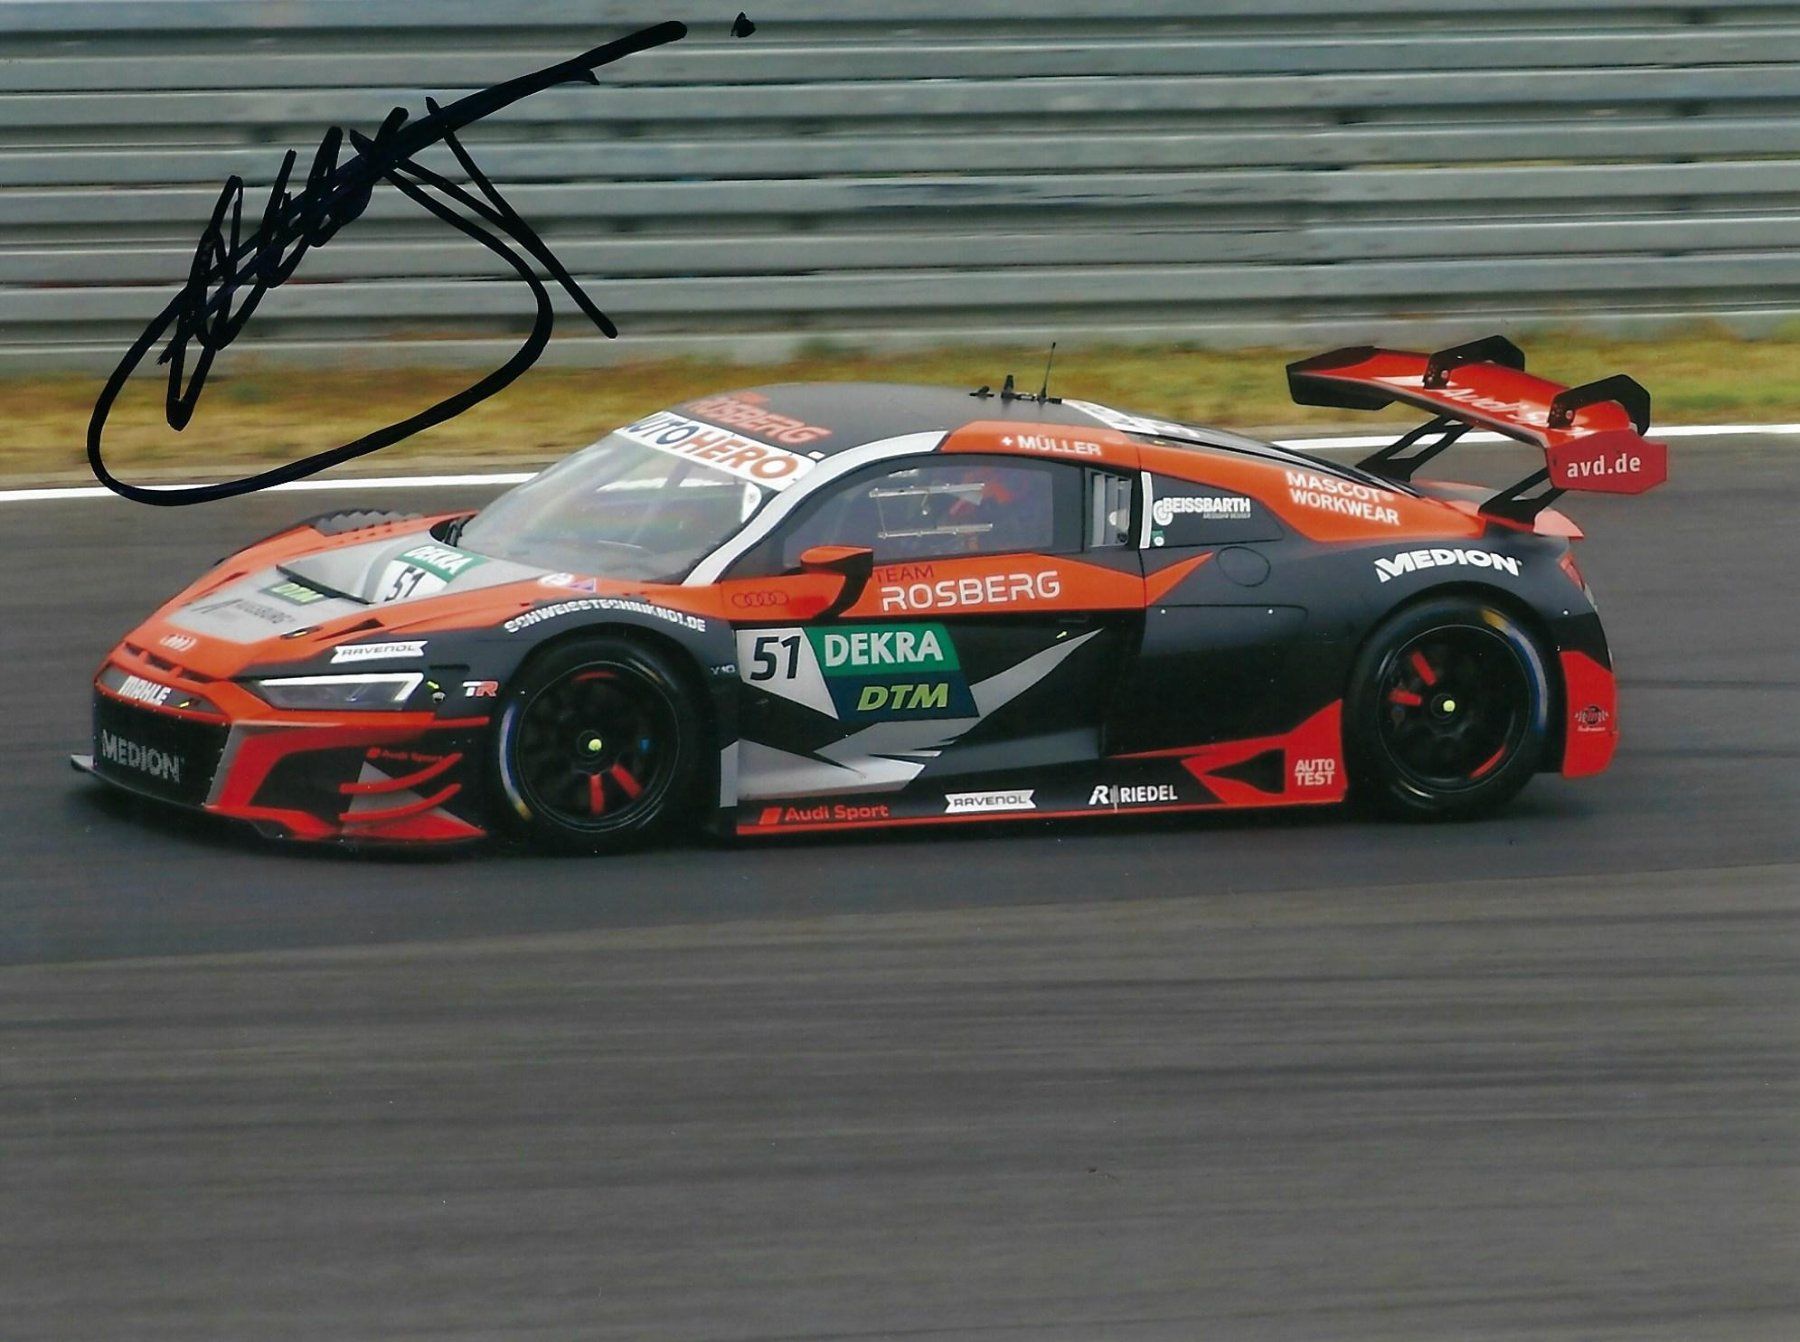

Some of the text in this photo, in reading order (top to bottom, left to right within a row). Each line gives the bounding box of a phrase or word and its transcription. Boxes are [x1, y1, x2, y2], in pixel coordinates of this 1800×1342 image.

[626, 413, 799, 479] UTOHERO
[1017, 435, 1102, 456] MÜLLER
[1566, 453, 1642, 479] avd.de
[1163, 497, 1251, 513] BEISSBARTH
[1290, 488, 1399, 525] WORKWEAR
[876, 565, 935, 583] TEAM
[1374, 549, 1518, 583] MEDION
[384, 566, 427, 602] 51
[881, 570, 1060, 612] ROSBERG
[750, 636, 801, 680] 51
[824, 630, 944, 667] DEKRA
[856, 682, 949, 711] DTM
[102, 729, 180, 783] MEDION
[1295, 758, 1335, 772] AUTO
[1120, 784, 1178, 803] RIEDEL
[1295, 772, 1335, 786] TEST
[784, 804, 889, 822] Audi Sport
